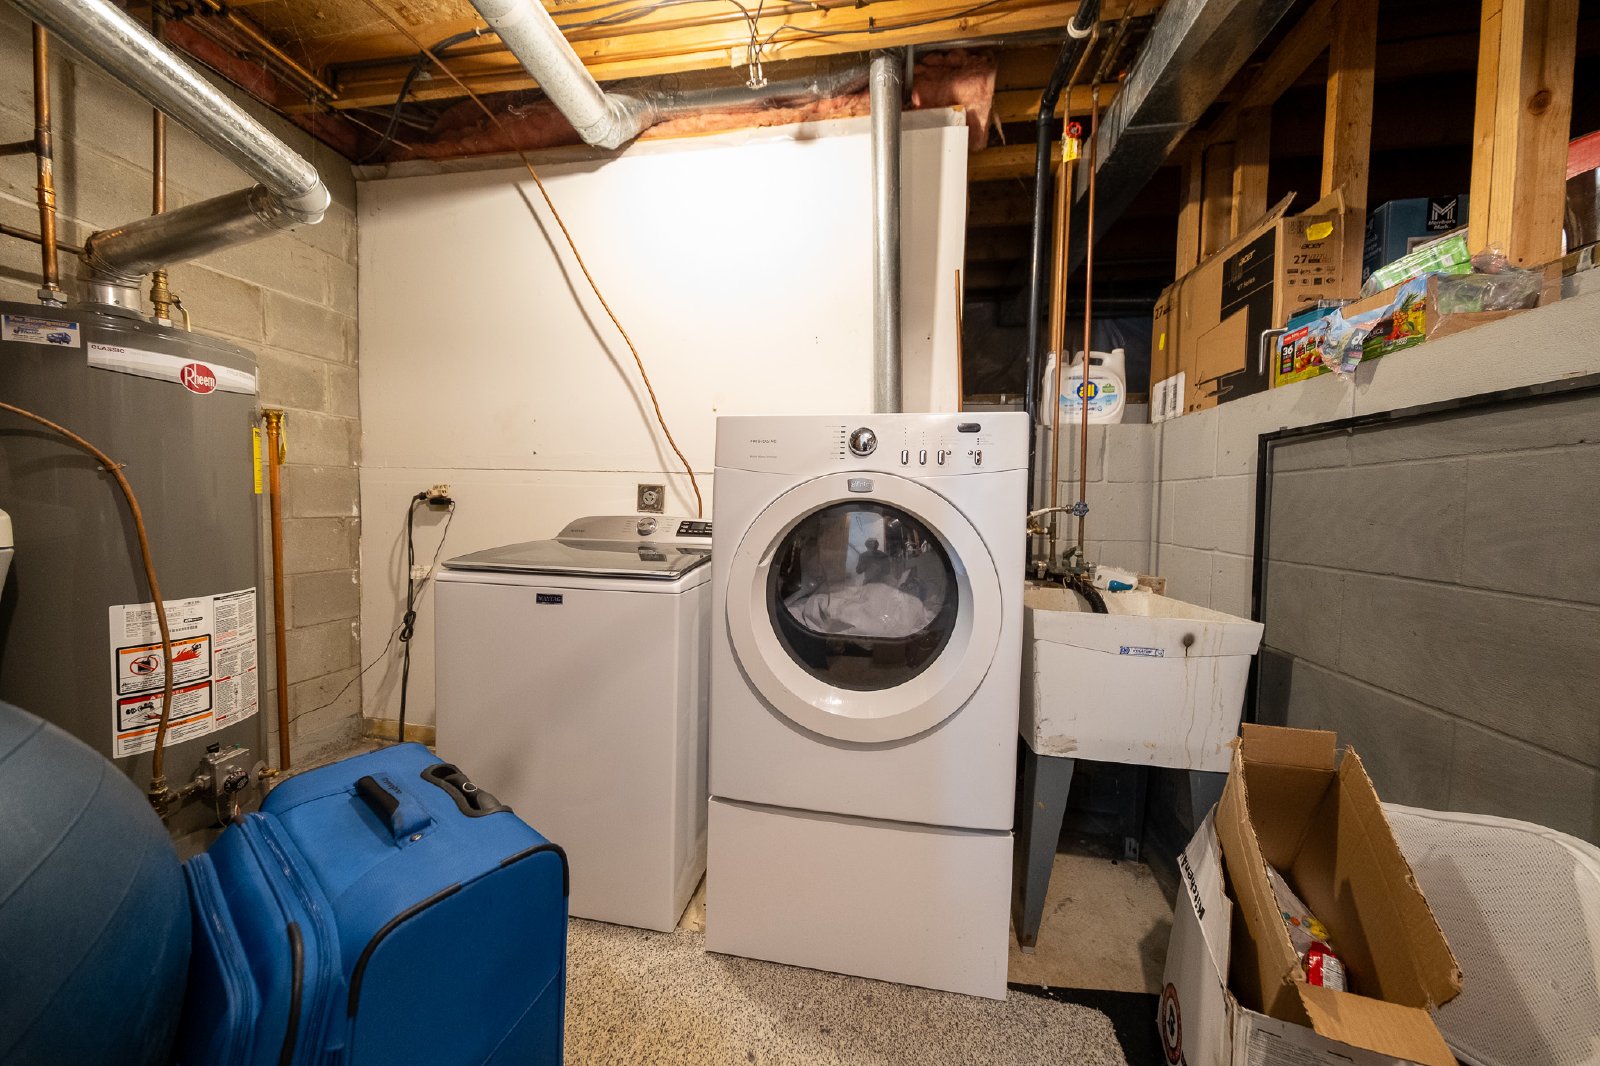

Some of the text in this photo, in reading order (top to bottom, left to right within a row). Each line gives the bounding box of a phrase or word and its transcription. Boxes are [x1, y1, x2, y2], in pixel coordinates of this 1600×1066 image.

[1427, 218, 1456, 226] Member's
[1300, 241, 1325, 250] acer
[1238, 249, 1256, 266] acer
[1293, 254, 1308, 264] 27
[91, 343, 125, 354] CLASSIC
[1283, 345, 1294, 356] 36
[184, 363, 215, 390] Rheem
